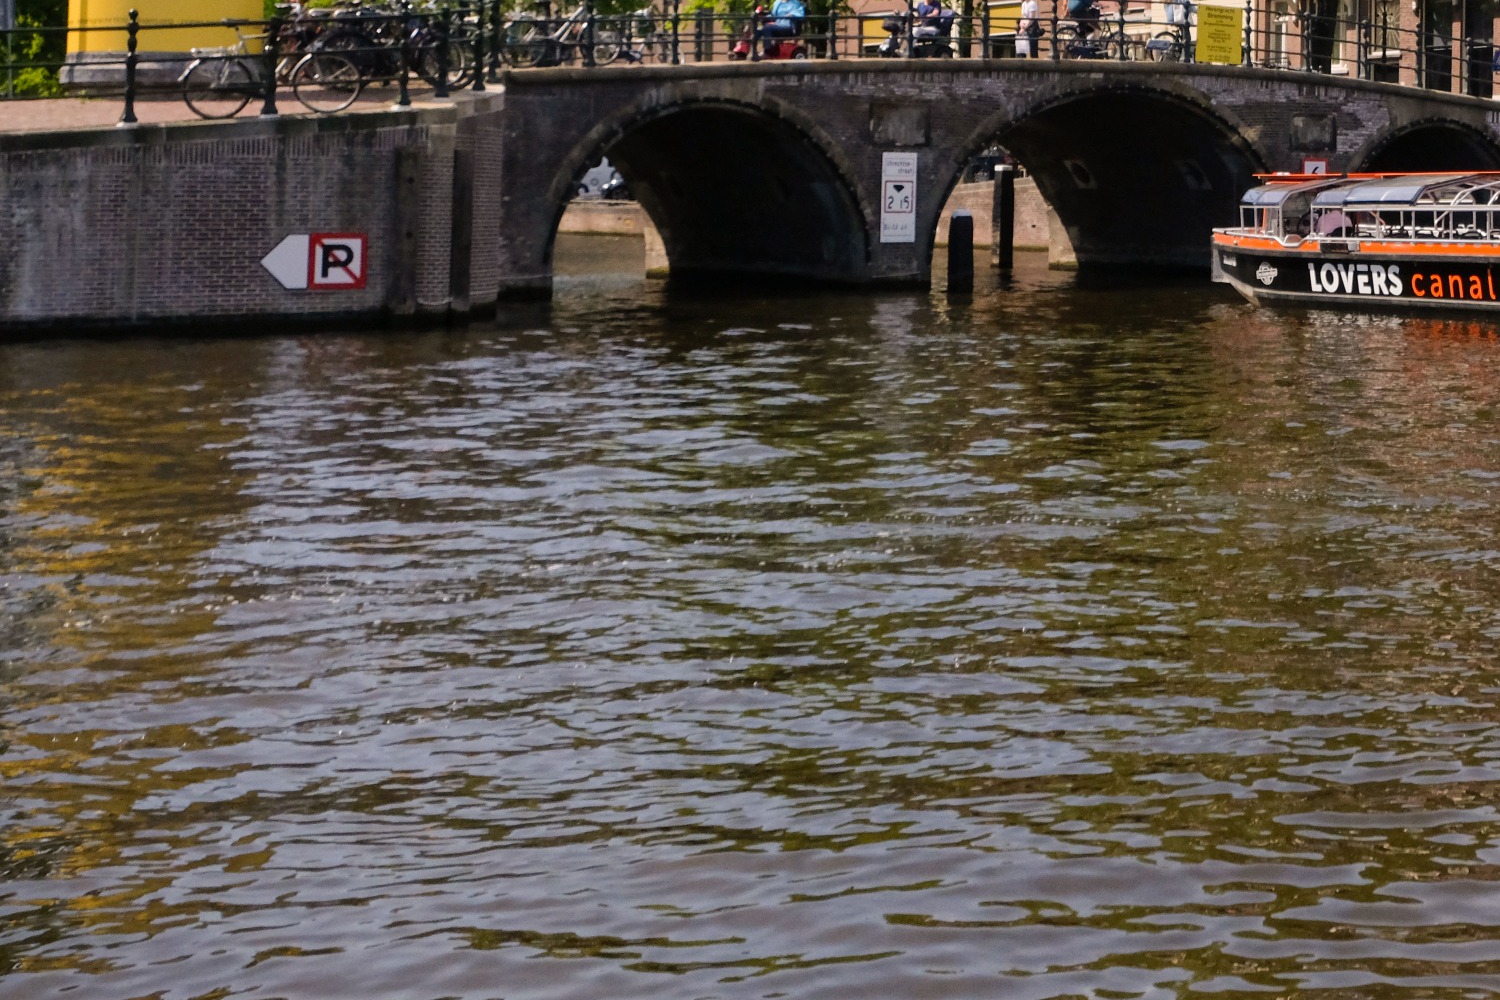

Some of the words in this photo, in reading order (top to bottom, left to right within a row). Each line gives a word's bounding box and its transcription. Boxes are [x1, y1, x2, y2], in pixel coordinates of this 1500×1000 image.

[321, 244, 354, 278] P
[1307, 262, 1403, 296] LOVERS
[1411, 268, 1496, 300] canal
